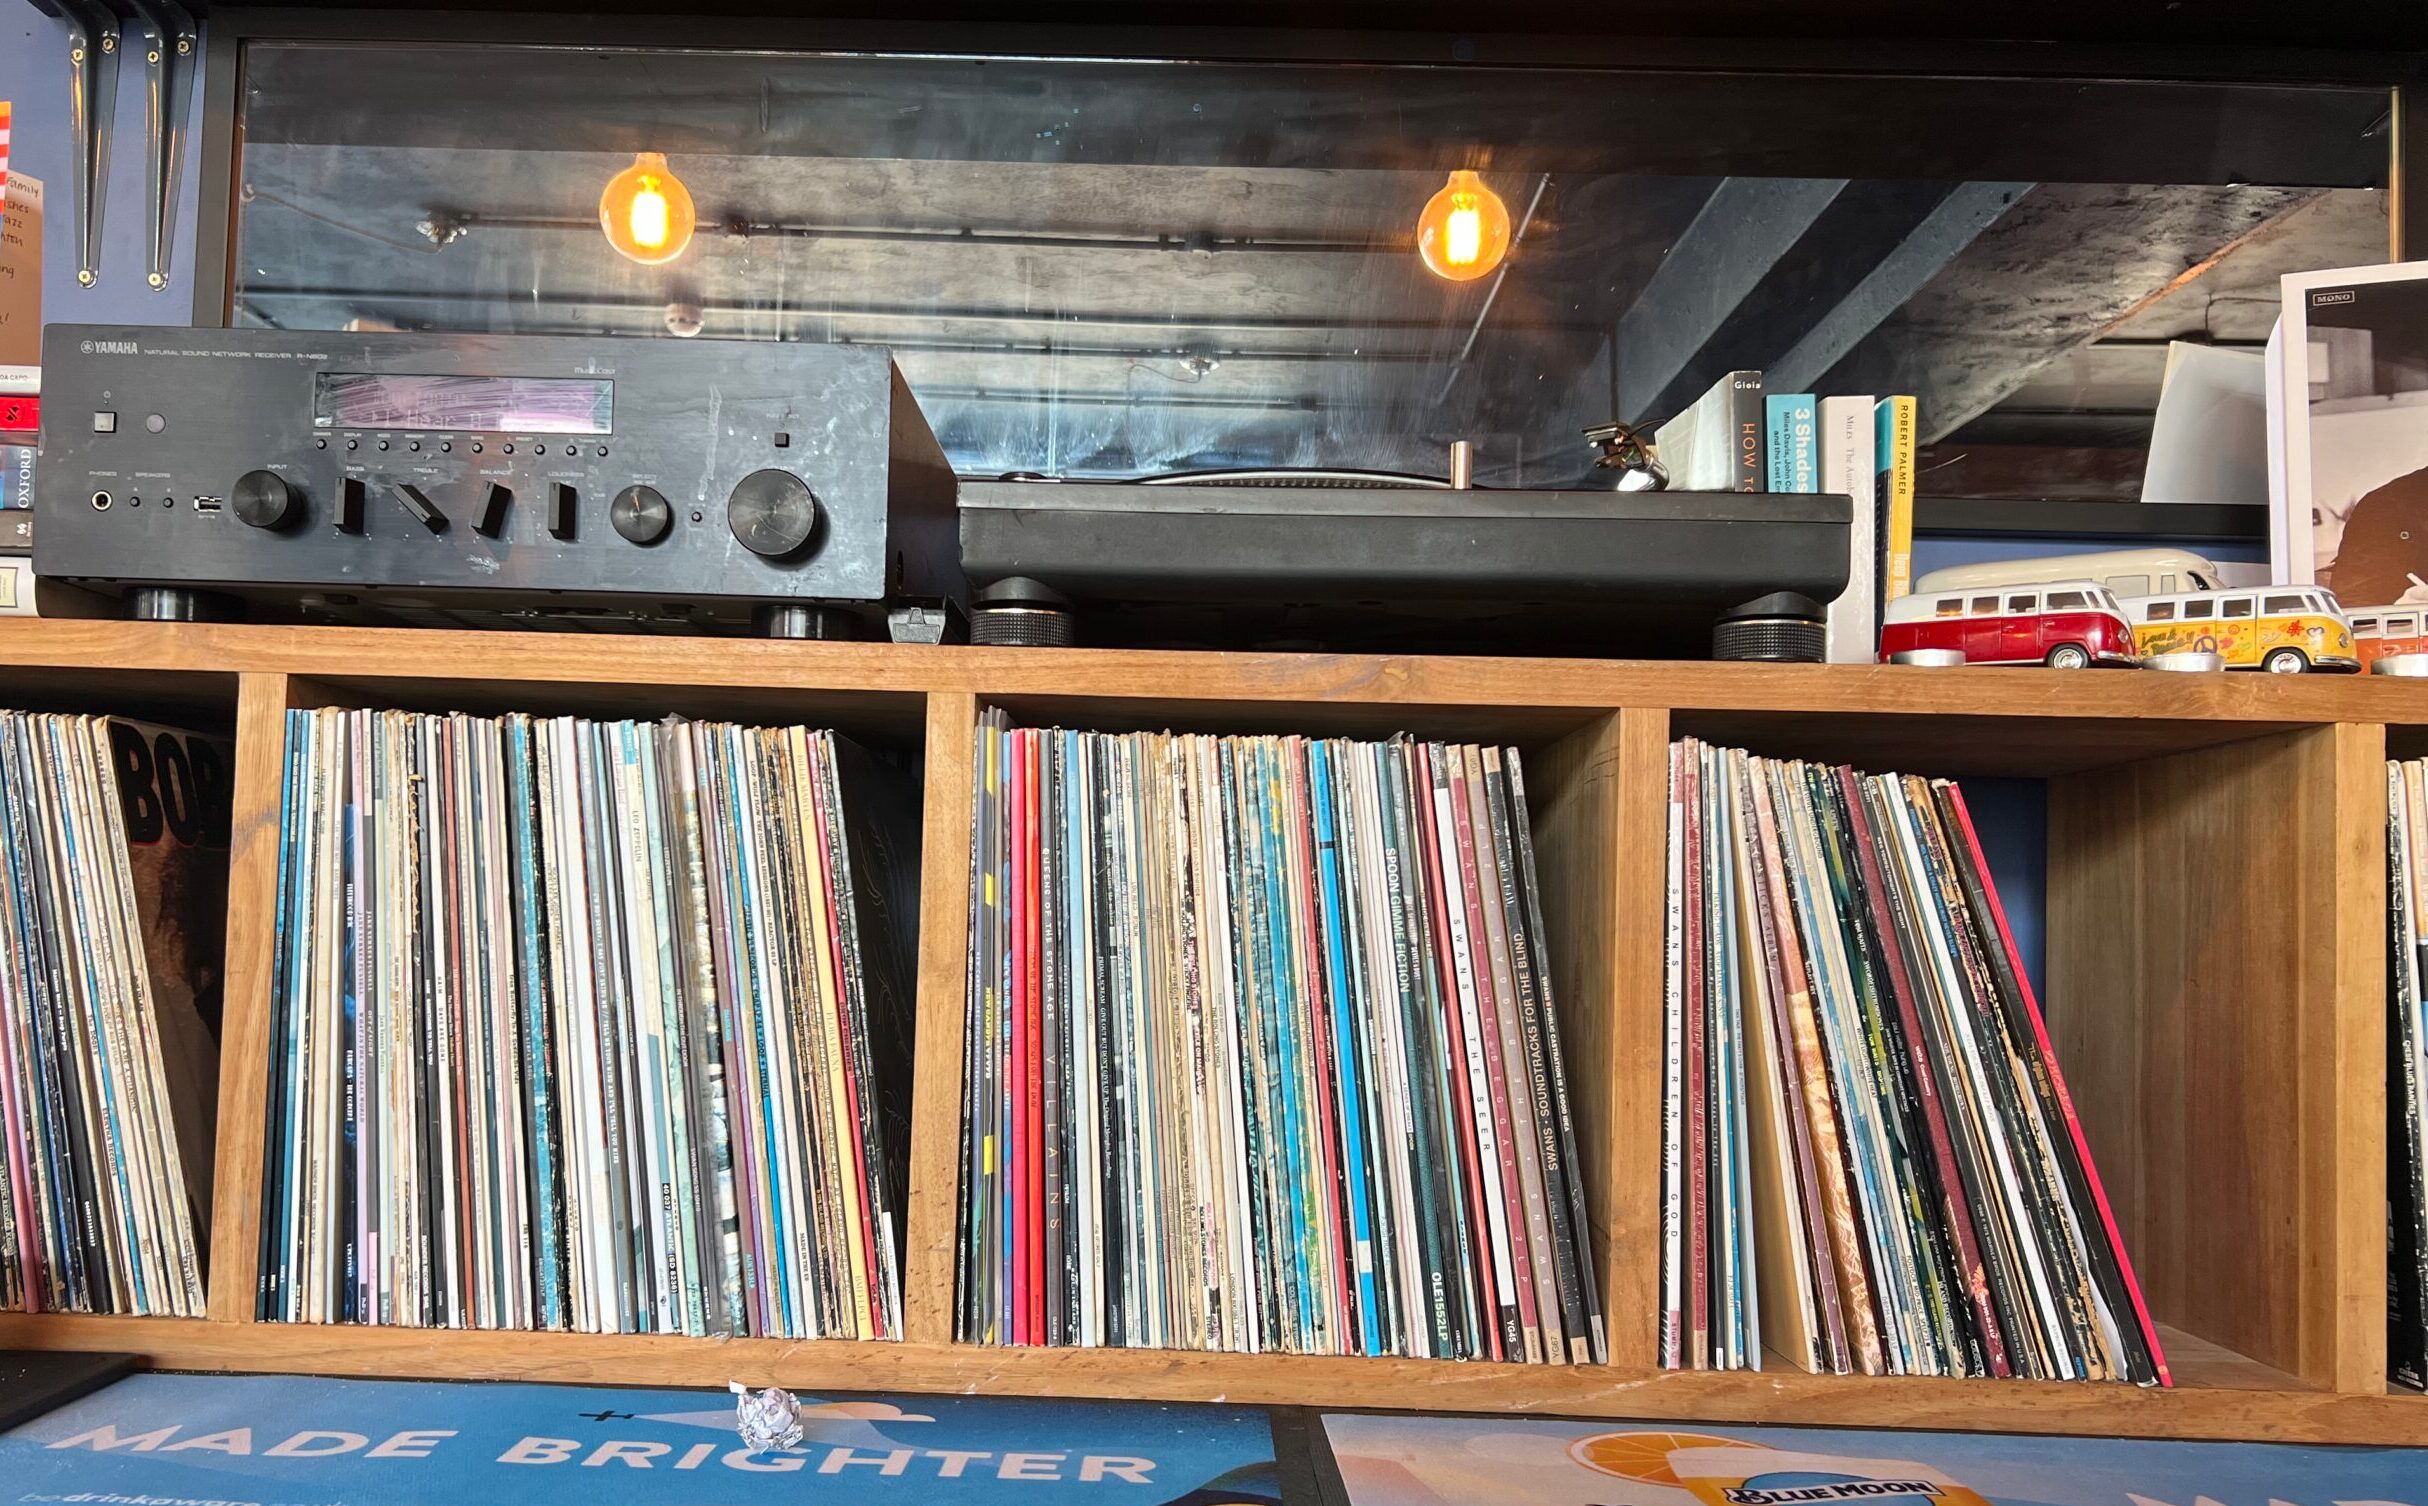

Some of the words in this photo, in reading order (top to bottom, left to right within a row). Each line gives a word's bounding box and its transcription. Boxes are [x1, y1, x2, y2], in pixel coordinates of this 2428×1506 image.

[2316, 292, 2352, 304] MONO
[95, 342, 138, 354] YAMAHA
[1734, 380, 1761, 390] Gioia
[1783, 411, 1791, 433] Miles
[1794, 408, 1811, 420] 3
[1900, 404, 1908, 448] ROBERT
[1742, 423, 1756, 468] HOW
[1784, 434, 1792, 458] Davis,
[1795, 424, 1812, 492] Shades
[1846, 448, 1855, 460] The
[18, 448, 32, 509] OXFORD
[1898, 452, 1908, 495] PALMER
[750, 760, 758, 777] LOOP
[797, 754, 806, 780] BILLIE
[752, 781, 760, 796] WOLF
[800, 785, 811, 820] MARTEN
[634, 827, 642, 862] ZEPPELIN
[1808, 814, 1824, 858] UNDERGROUND
[1877, 836, 1885, 846] NEIL
[761, 865, 770, 891] SESSIONS
[1042, 847, 1051, 894] QUEENS
[1385, 847, 1399, 892] SPOON
[1044, 902, 1051, 916] OF
[1390, 895, 1404, 939] GIMME
[1893, 900, 1901, 909] THE
[1672, 888, 1680, 967] SWANS
[1854, 919, 1862, 932] TOM
[1895, 910, 1906, 928] NIGHT
[1044, 923, 1052, 943] THE
[1857, 934, 1866, 951] WAITS
[1514, 932, 1528, 968] BLIND
[51, 968, 60, 991] Machine
[1045, 951, 1054, 984] STONE
[1395, 943, 1409, 992] FICTION
[1098, 979, 1106, 1003] SCREAM
[1520, 972, 1531, 995] THE
[1863, 960, 1884, 1030] SWORDFISHTROMBONES
[54, 994, 62, 1008] Head
[840, 1002, 848, 1025] DROP
[1047, 996, 1055, 1020] AGE
[1524, 999, 1535, 1022] FOR
[57, 1016, 65, 1030] Deep
[826, 1011, 836, 1039] FLORA
[1546, 1007, 1555, 1032] PUBLIC
[90, 1030, 99, 1055] DOORS
[604, 1038, 610, 1047] ME
[758, 1038, 766, 1057] LOOP
[1454, 920, 1469, 990] SWANS
[1470, 1037, 1480, 1075] THE
[1477, 1096, 1490, 1150] SEER
[830, 1042, 839, 1071] FAUNA
[1550, 1034, 1562, 1078] CASTRATION
[1671, 991, 1679, 1118] CHILDREN
[1856, 1027, 1865, 1042] WHITE
[1868, 1082, 1877, 1098] HEAT
[1914, 1046, 1924, 1061] WILCO
[2404, 1039, 2412, 1061] CHESS
[1528, 1026, 1550, 1116] SOUNDTRACKS
[1919, 1065, 1927, 1076] Cruel
[2406, 1062, 2414, 1083] BLUES
[1102, 1085, 1109, 1093] UP
[1922, 1077, 1932, 1096] Country
[1558, 1095, 1567, 1113] GOOD
[2408, 1086, 2416, 1114] RARITIES
[1562, 1116, 1570, 1131] IDEA
[102, 1108, 112, 1139] ELEKTRA
[107, 1144, 117, 1176] RECORDS
[1046, 1055, 1060, 1230] VILLAINS
[1548, 1128, 1558, 1170] SWANS
[1104, 1151, 1112, 1178] Recordings
[1671, 1142, 1678, 1169] OF
[662, 1184, 669, 1194] 40
[664, 1212, 674, 1251] ATLANTIC
[1531, 1193, 1550, 1286] SWANS
[1906, 1255, 1918, 1282] POLYDOR
[1984, 1236, 1997, 1259] WARNER
[1996, 1278, 2009, 1304] RECORDS
[2007, 1317, 2019, 1339] PRINTED
[1432, 1272, 1448, 1341] OLE1552LP
[1506, 1320, 1516, 1343] YG45
[44, 1424, 460, 1459] MADE
[496, 1436, 1158, 1484] BRIGHTER
[1729, 1486, 1836, 1504] BLUE
[1836, 1479, 1930, 1498] MOON
